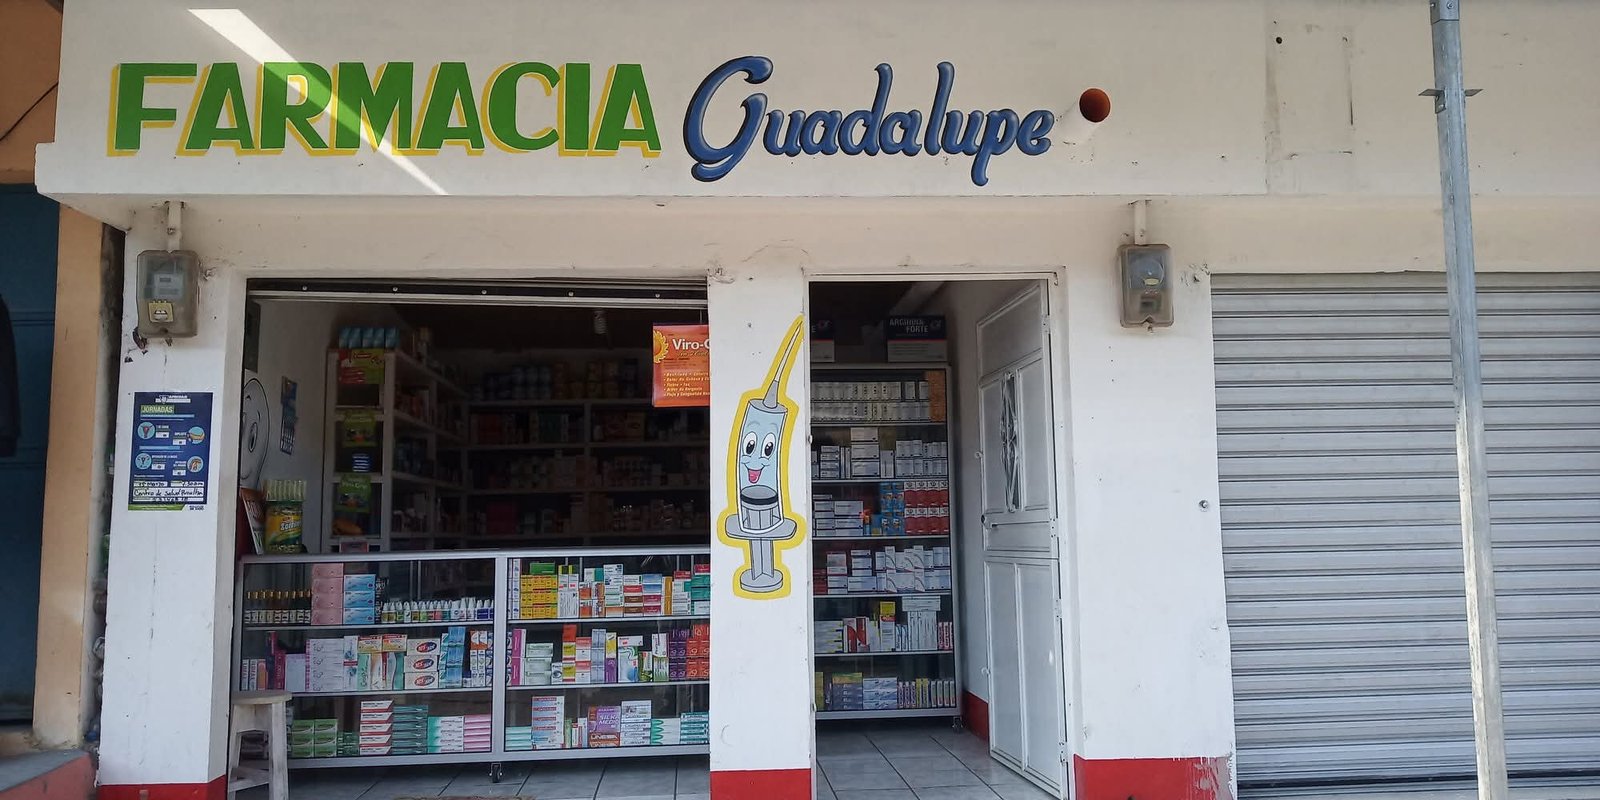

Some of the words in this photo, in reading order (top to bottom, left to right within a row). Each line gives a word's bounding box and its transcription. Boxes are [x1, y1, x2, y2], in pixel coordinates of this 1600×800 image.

[108, 61, 662, 156] FARMACIA
[682, 55, 1056, 187] Guadalupe
[906, 325, 929, 333] FORTE
[141, 405, 173, 413] JORNADAS
